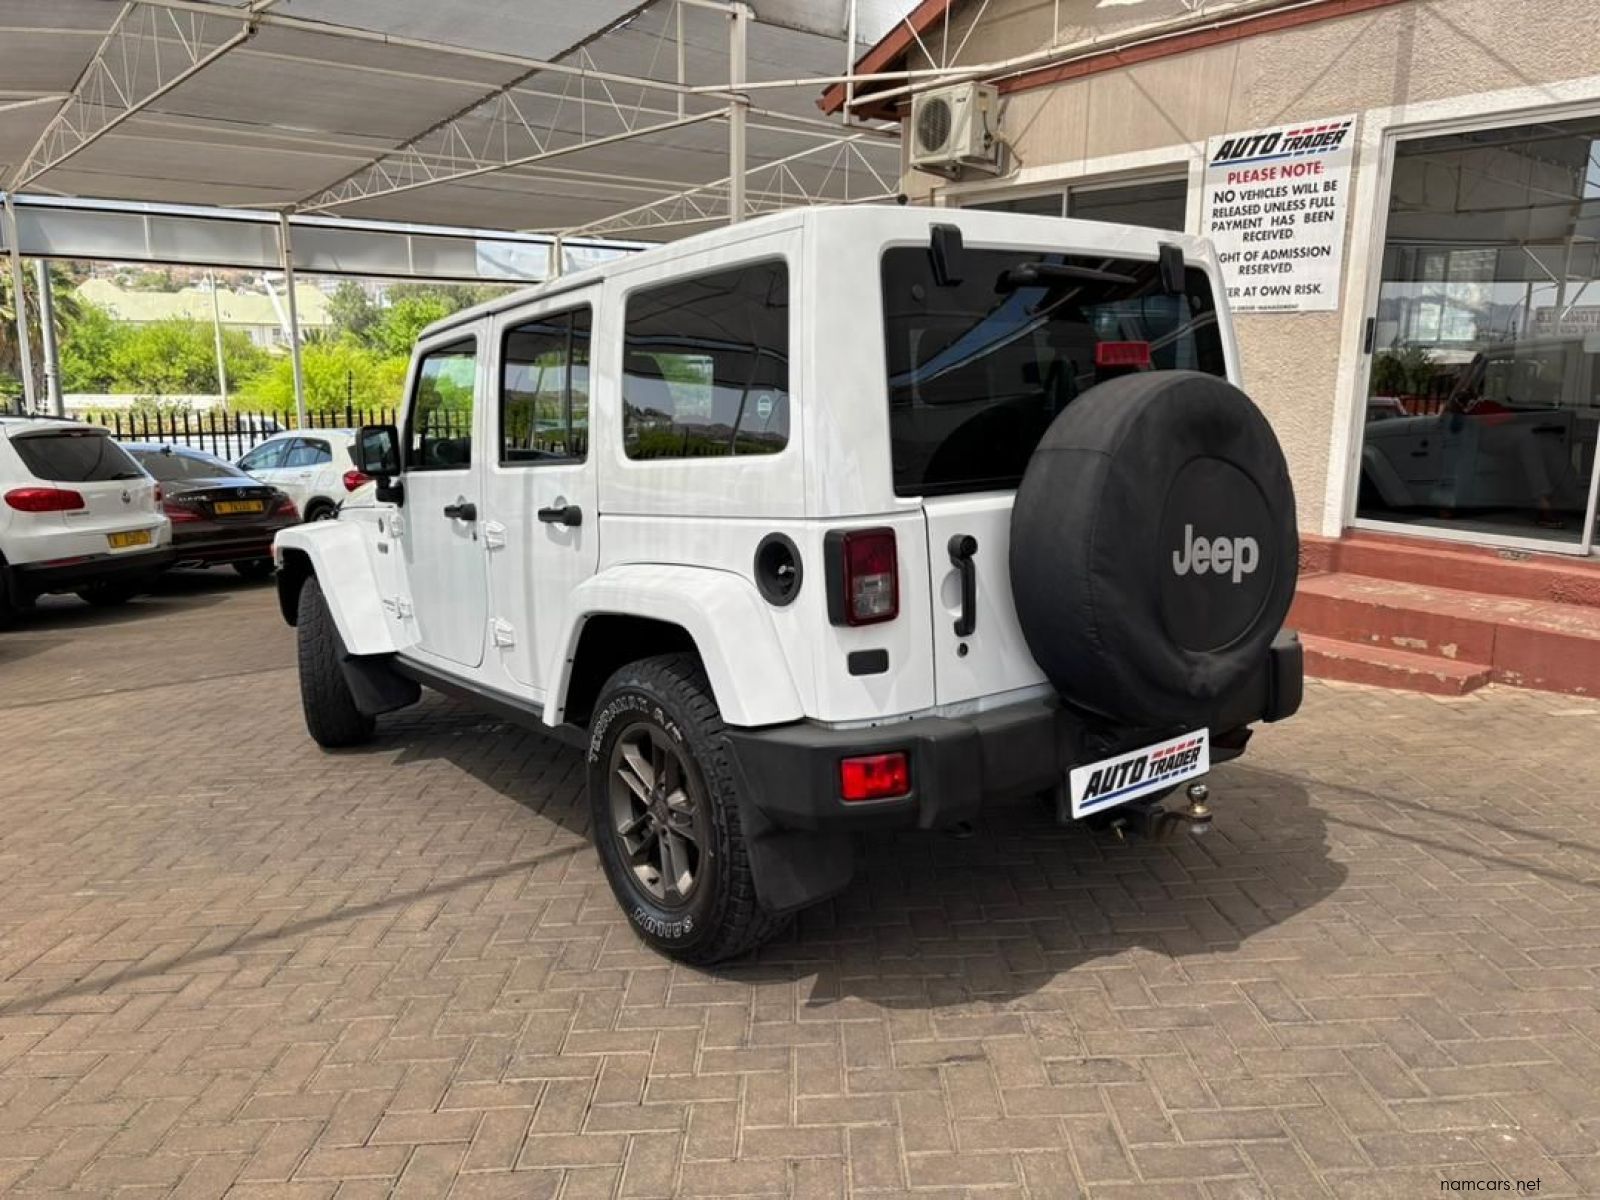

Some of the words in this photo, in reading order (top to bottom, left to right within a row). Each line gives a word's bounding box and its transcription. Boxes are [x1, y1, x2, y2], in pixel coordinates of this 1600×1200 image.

[1212, 132, 1284, 161] AUTO
[1280, 129, 1348, 153] TRADER
[1227, 167, 1277, 185] PLEASE
[1213, 190, 1236, 204] NO
[1239, 186, 1288, 201] VEHICLES
[1292, 182, 1319, 195] WILL
[1323, 180, 1338, 192] BE
[1212, 204, 1261, 219] RELEASED
[1263, 199, 1306, 214] UNLESS
[1309, 196, 1336, 209] FULL
[1211, 217, 1263, 232] PAYMENT
[1270, 214, 1295, 227] HAS
[1303, 211, 1334, 224] BEEN
[1244, 251, 1259, 262] OF
[1261, 245, 1332, 261] ADMISSION
[1243, 286, 1258, 297] AT
[1260, 285, 1291, 297] OWN
[1172, 523, 1259, 584] Jeep
[1082, 755, 1149, 801] AUTO
[1149, 745, 1202, 779] TRADER
